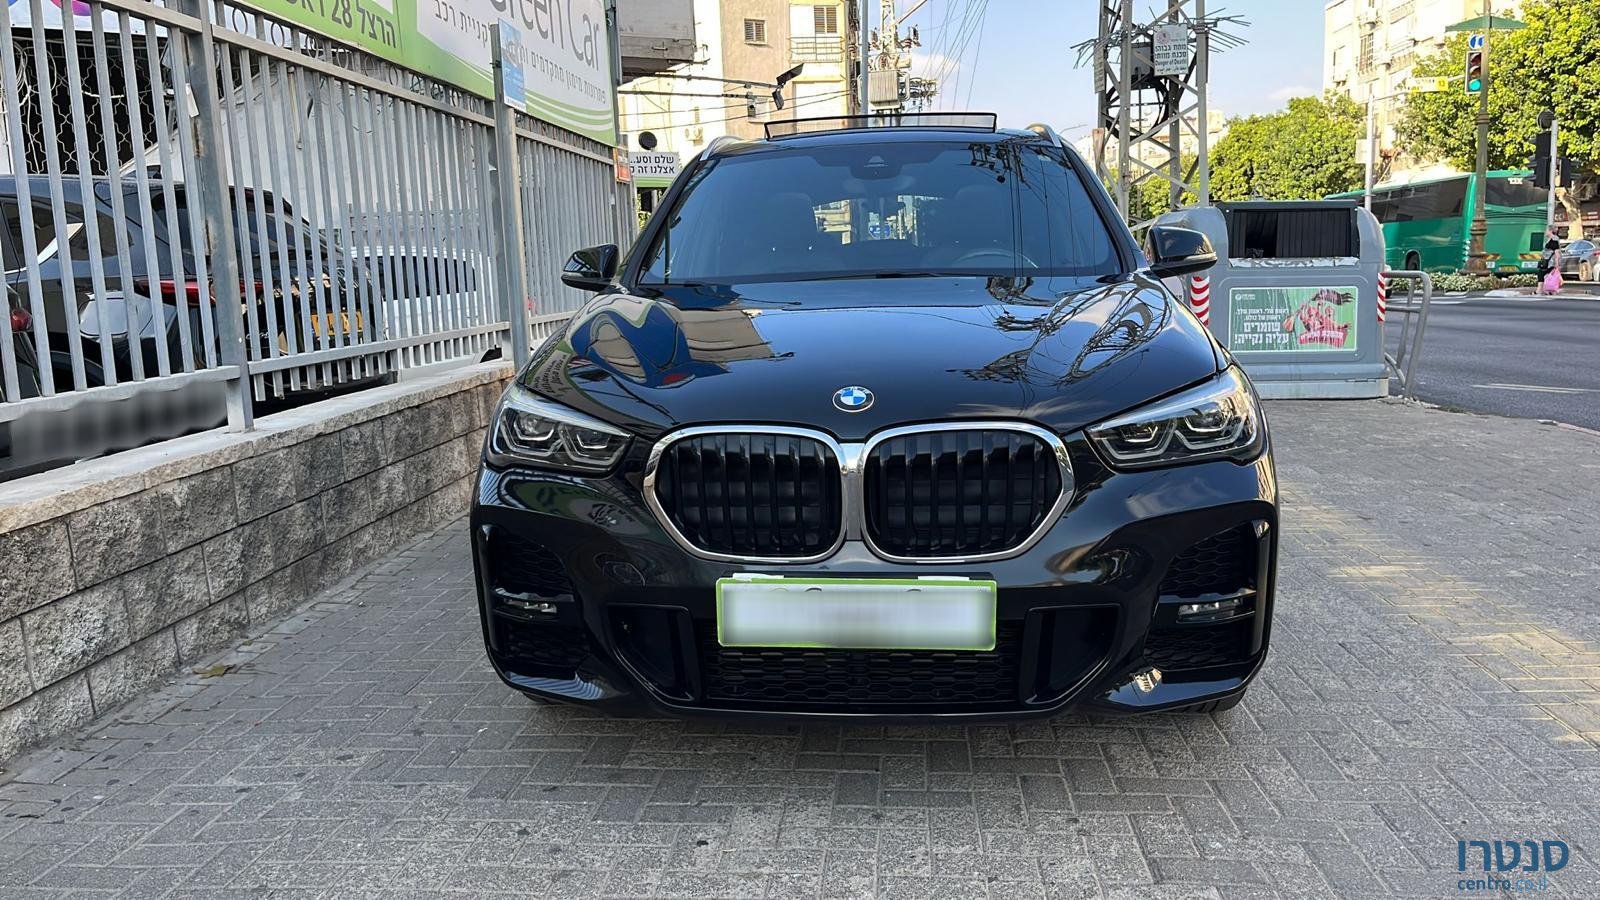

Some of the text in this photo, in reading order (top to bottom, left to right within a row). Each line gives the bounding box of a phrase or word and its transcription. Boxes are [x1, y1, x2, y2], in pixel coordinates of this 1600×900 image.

[332, 0, 352, 28] 28
[356, 0, 397, 48] הרצל
[435, 0, 456, 27] רכב
[459, 11, 490, 48] קניית
[489, 0, 599, 71] een Car
[531, 51, 564, 82] מתקדמים
[638, 166, 648, 174] זה
[650, 165, 675, 174] אצלנו
[654, 155, 674, 164] שלם
[1243, 321, 1281, 332] שומרים
